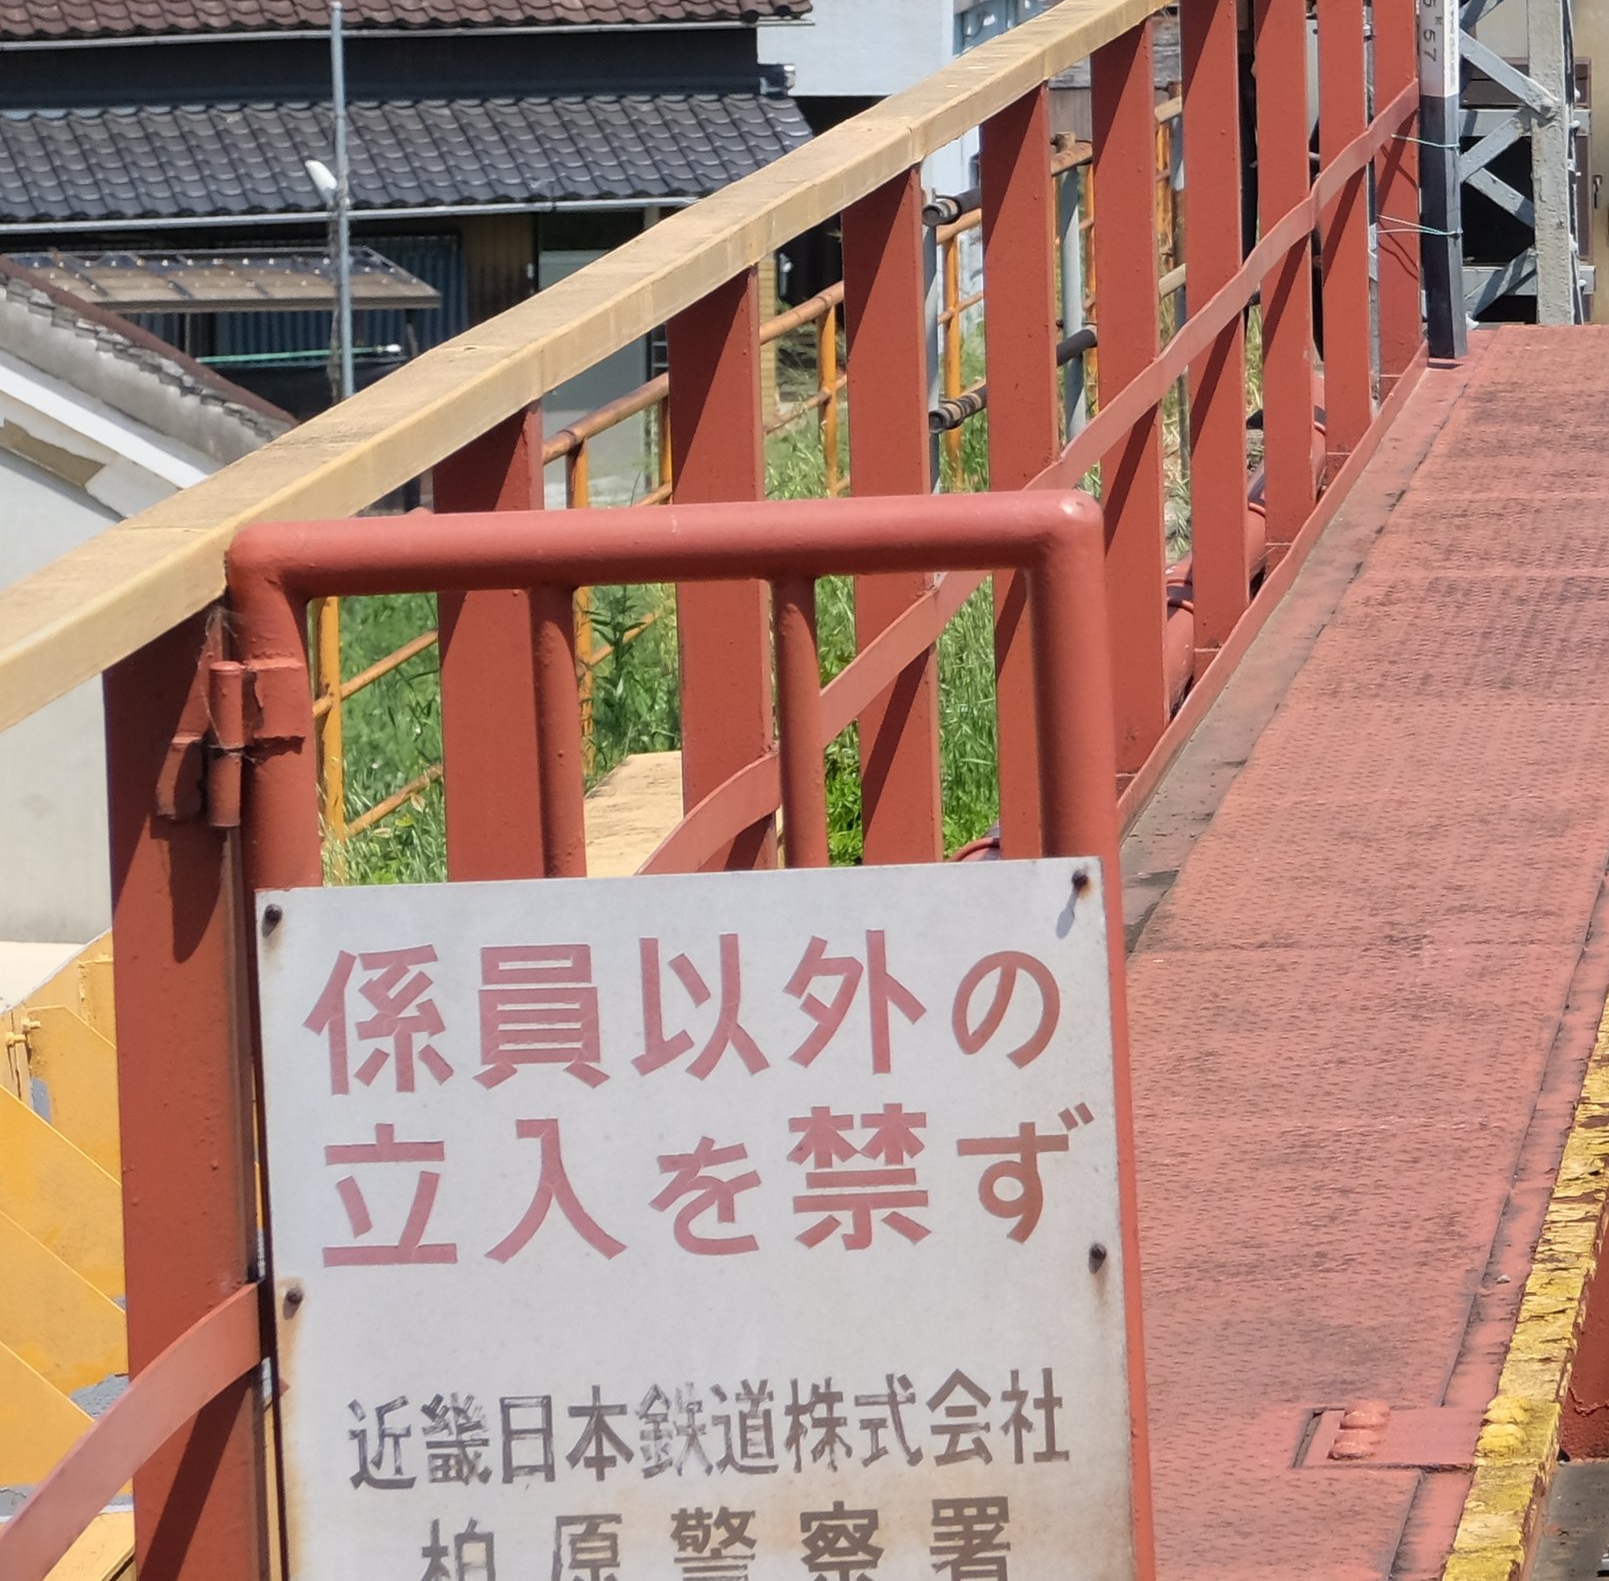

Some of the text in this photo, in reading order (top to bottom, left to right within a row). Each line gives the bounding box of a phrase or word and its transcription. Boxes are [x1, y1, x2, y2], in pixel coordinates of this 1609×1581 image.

[304, 929, 1062, 1096] 係員以外の
[322, 1102, 1094, 1268] 立入を禁ず
[348, 1367, 1070, 1491] 近畿日本鉄道株式会社
